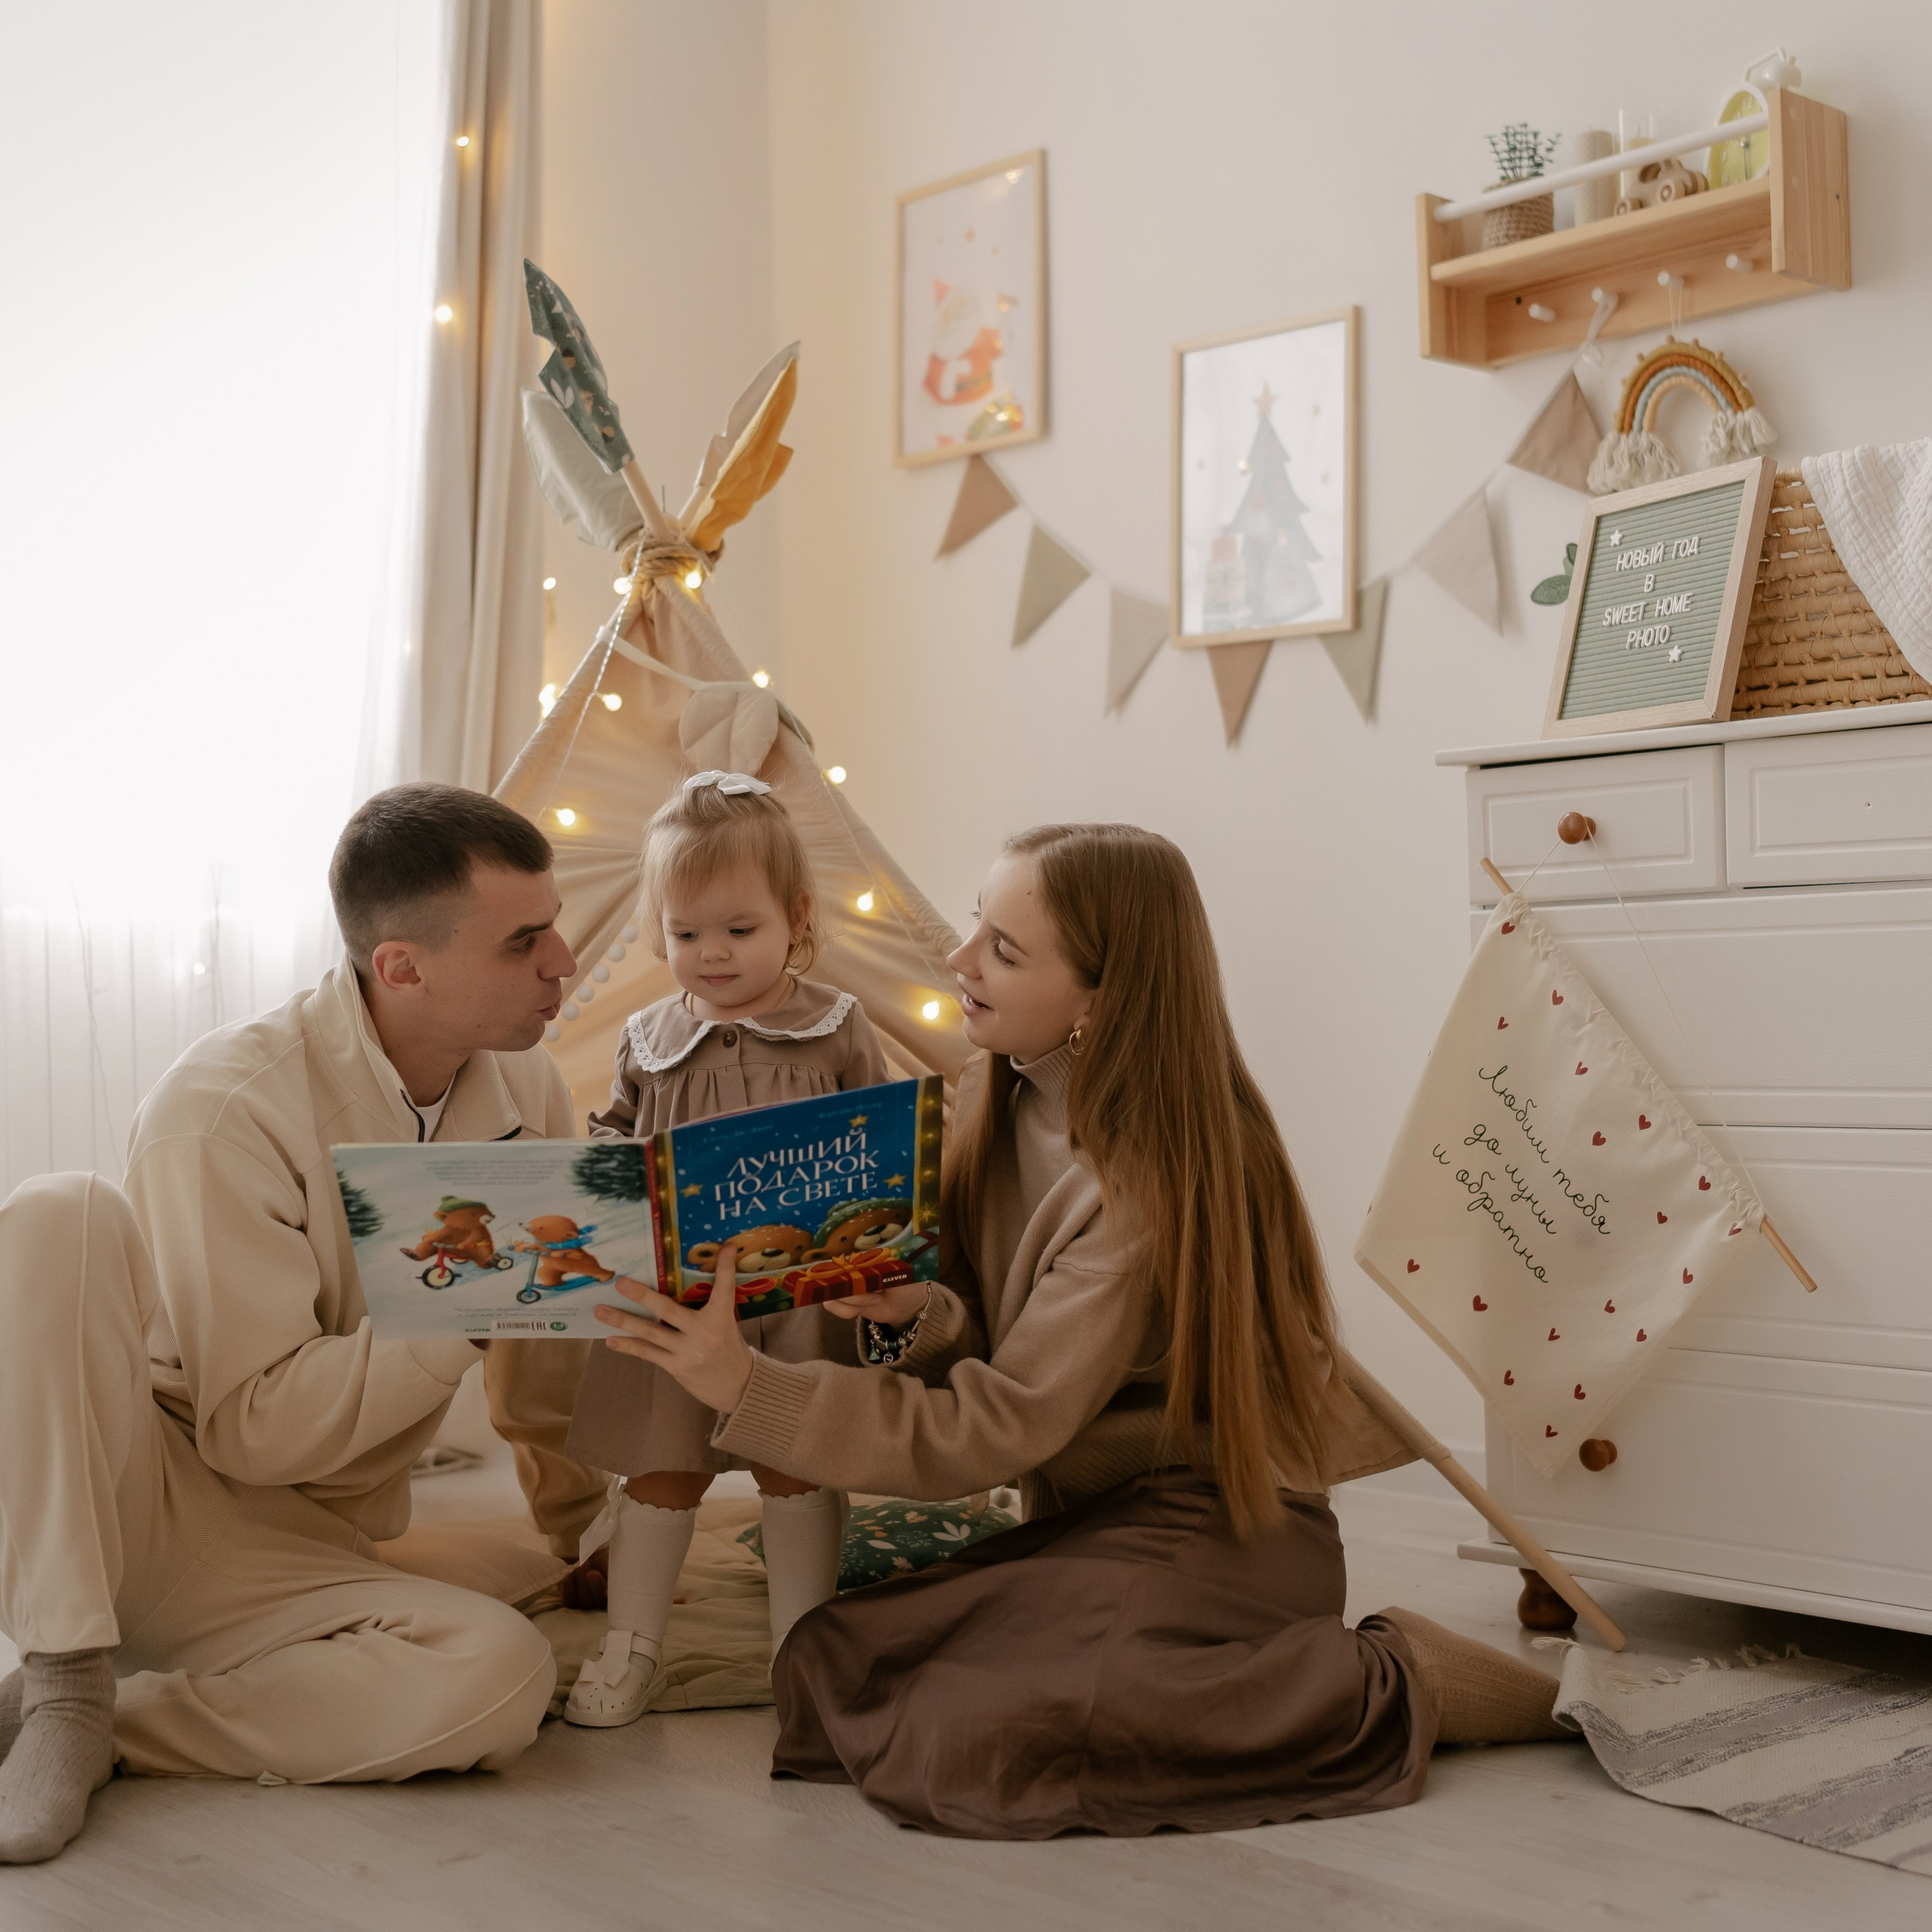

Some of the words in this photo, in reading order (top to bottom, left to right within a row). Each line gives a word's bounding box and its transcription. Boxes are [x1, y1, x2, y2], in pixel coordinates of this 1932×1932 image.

[1616, 541, 1666, 572] НОВЫЙ
[1672, 536, 1700, 560] ГОД
[1602, 601, 1647, 627] SWEET
[1654, 592, 1694, 618] HOME
[1626, 624, 1671, 650] PHOTO
[715, 1149, 879, 1201] ПОДАРОК
[726, 1127, 866, 1179] ЛУЧШИЙ
[720, 1195, 768, 1220] НА
[778, 1171, 878, 1206] СВЕТЕ
[1463, 1124, 1502, 1155] до
[1505, 1164, 1557, 1235] луны
[1552, 1169, 1611, 1235] тебя
[1432, 1143, 1451, 1164] и
[1455, 1169, 1549, 1283] обратно
[882, 1274, 907, 1283] CLEVER
